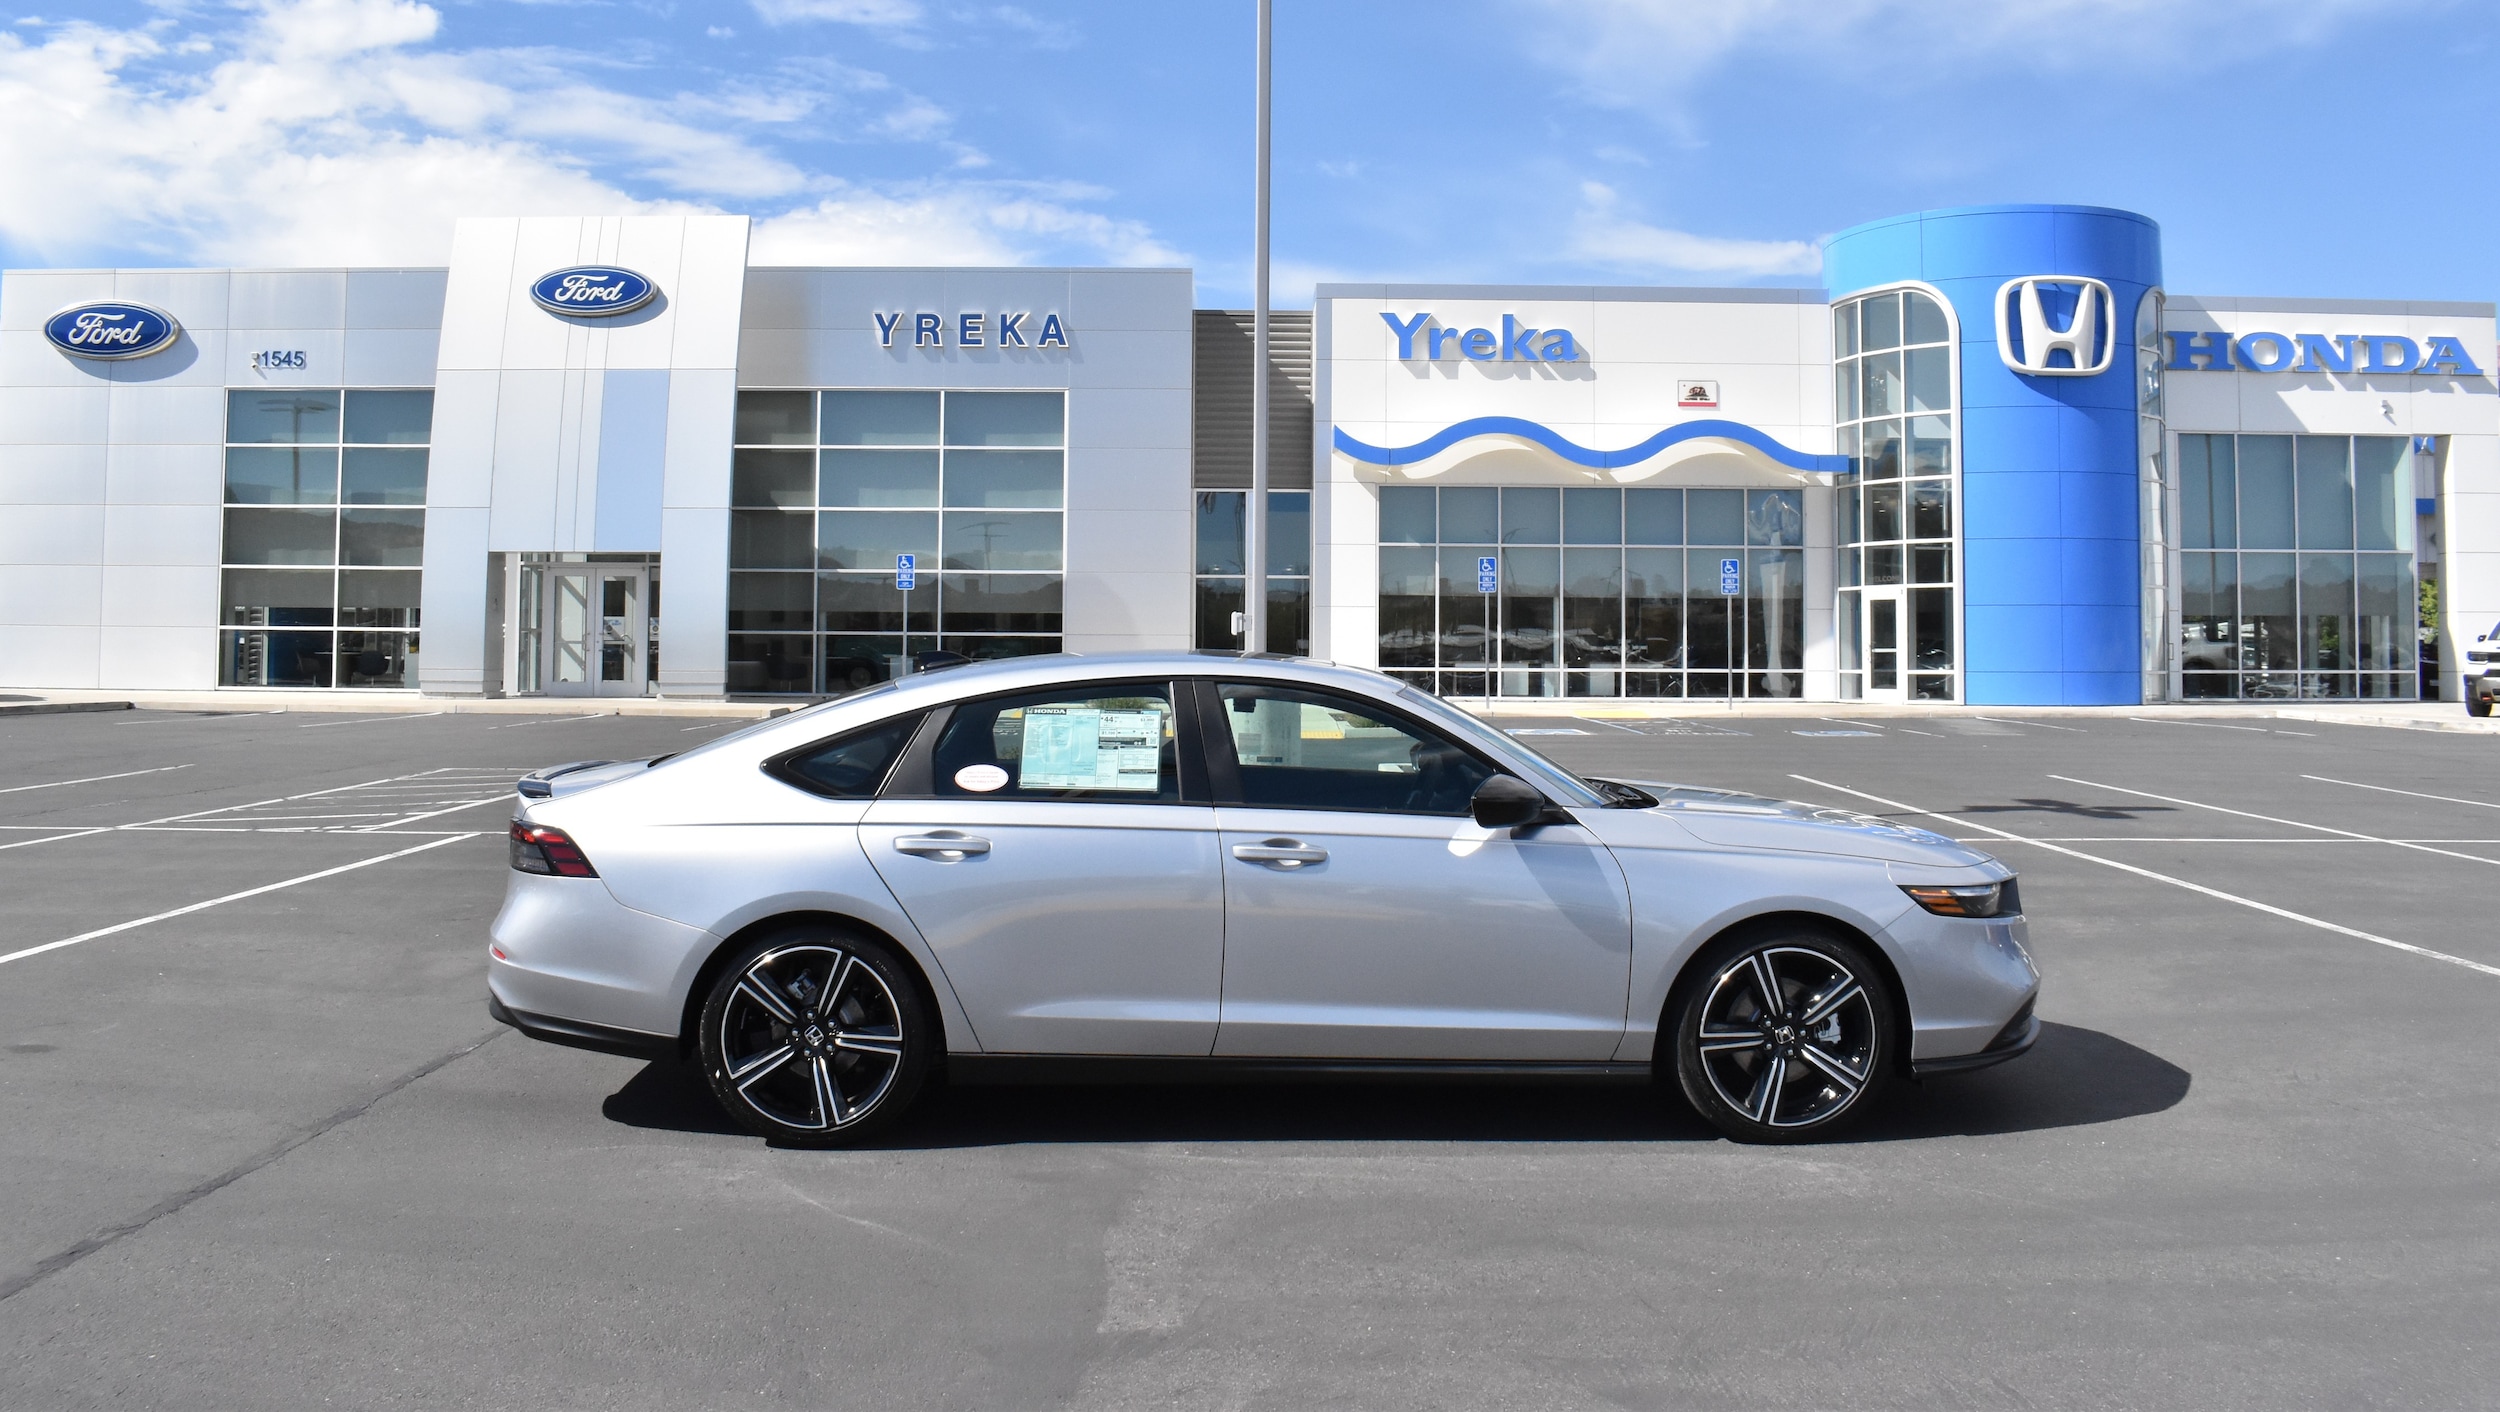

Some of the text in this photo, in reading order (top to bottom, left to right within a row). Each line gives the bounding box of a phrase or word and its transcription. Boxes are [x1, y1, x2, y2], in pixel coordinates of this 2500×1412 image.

[554, 274, 626, 302] Ford
[68, 312, 144, 345] Ford
[872, 311, 1070, 348] YREKA
[1378, 312, 1580, 362] Yreka
[261, 350, 305, 368] 1545
[2163, 330, 2485, 376] HONDA
